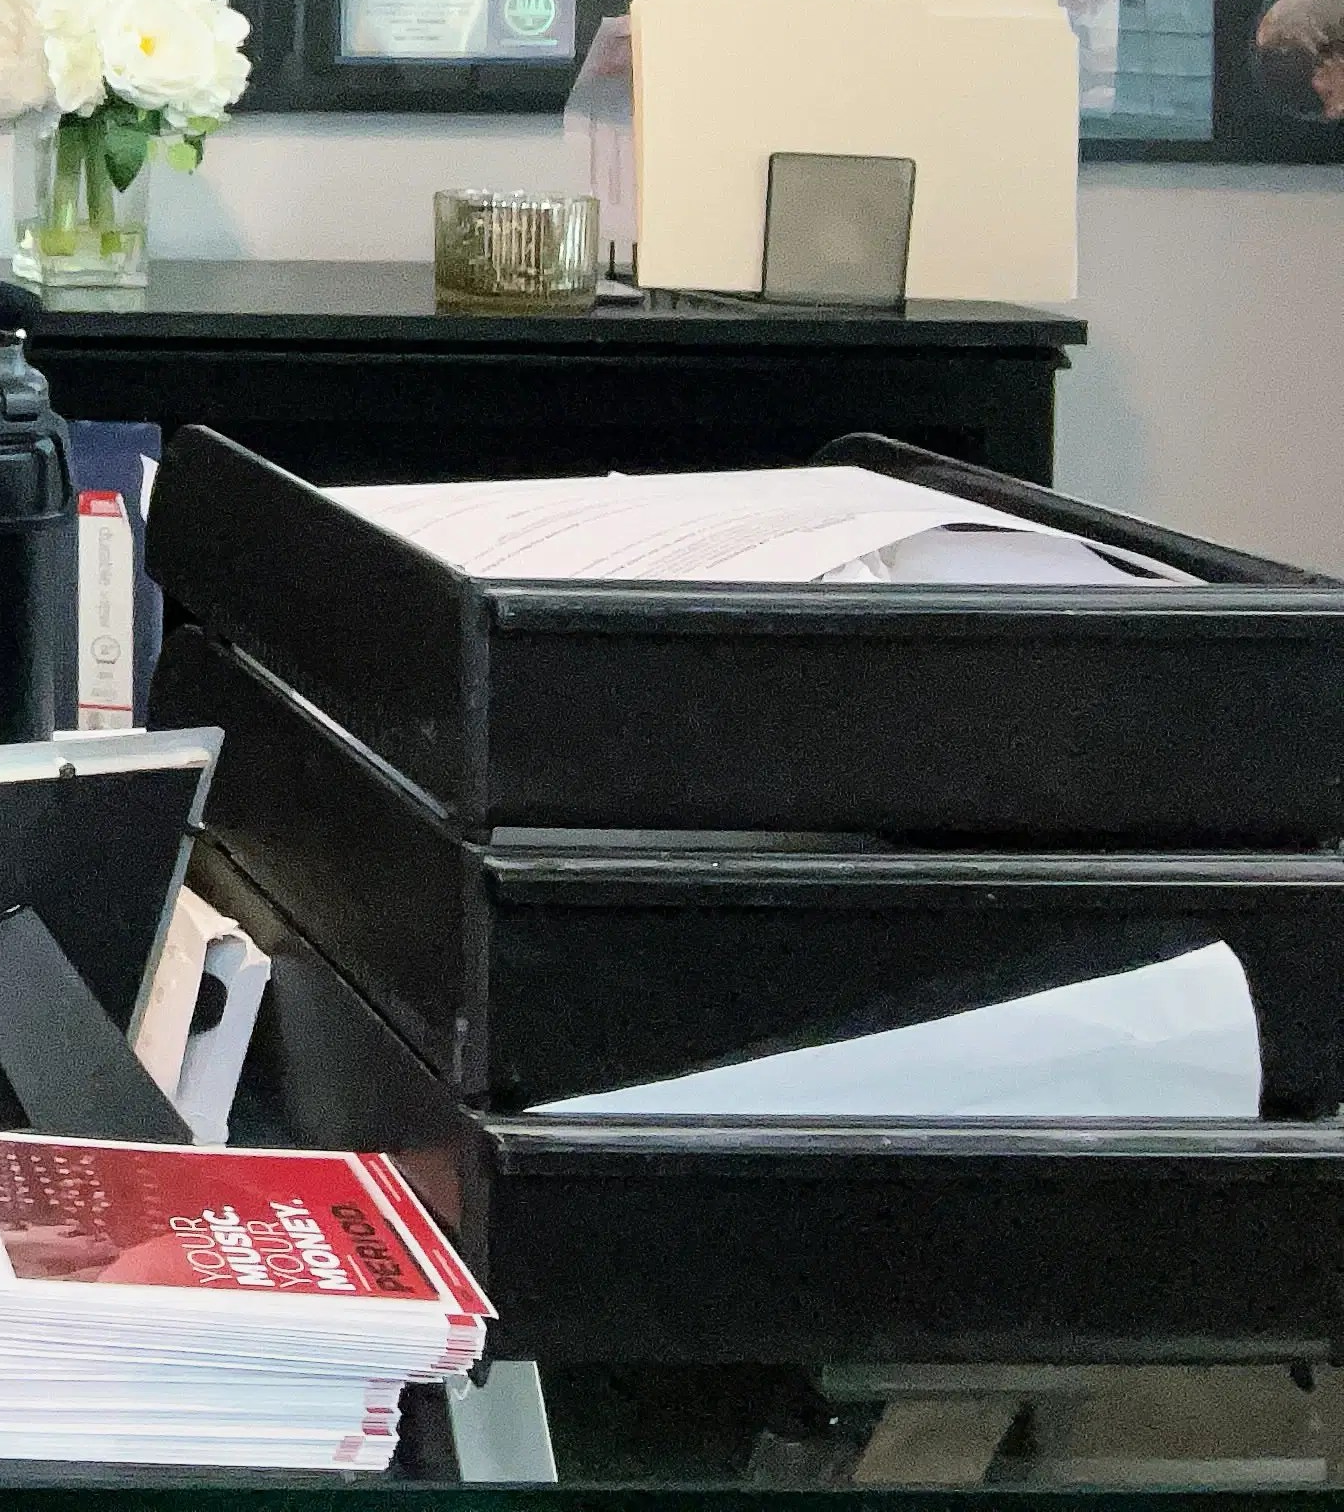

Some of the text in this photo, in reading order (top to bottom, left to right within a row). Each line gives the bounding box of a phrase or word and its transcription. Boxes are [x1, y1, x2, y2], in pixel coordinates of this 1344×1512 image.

[169, 1215, 234, 1284] YOUR
[202, 1204, 276, 1287] MUSIC.
[246, 1219, 314, 1288] YOUR
[269, 1197, 357, 1291] MONEY.
